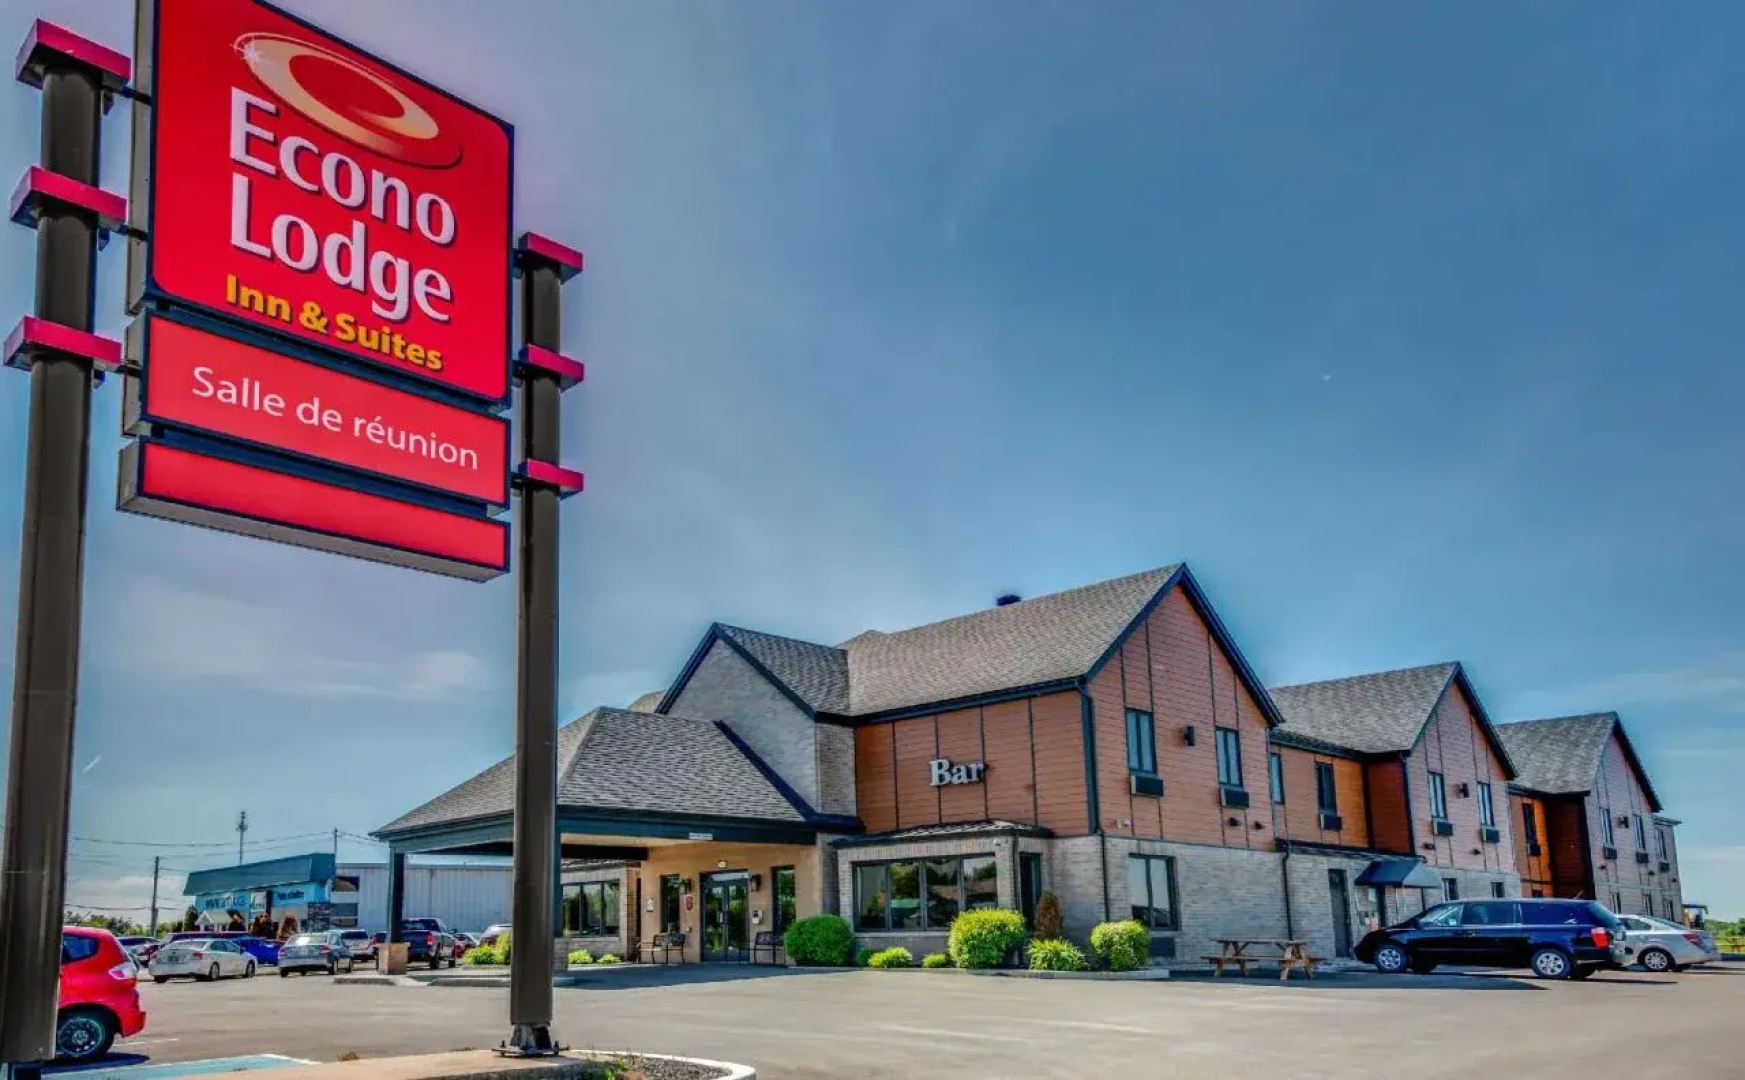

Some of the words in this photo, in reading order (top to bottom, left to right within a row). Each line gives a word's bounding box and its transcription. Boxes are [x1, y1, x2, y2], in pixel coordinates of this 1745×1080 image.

[229, 86, 456, 245] Econo
[230, 172, 452, 322] Lodge
[226, 274, 291, 323] Inn
[299, 301, 328, 334] &
[335, 312, 444, 371] Suites
[191, 366, 286, 417] Salle
[296, 397, 343, 432] de
[353, 415, 479, 470] réunion
[929, 758, 985, 786] Bar
